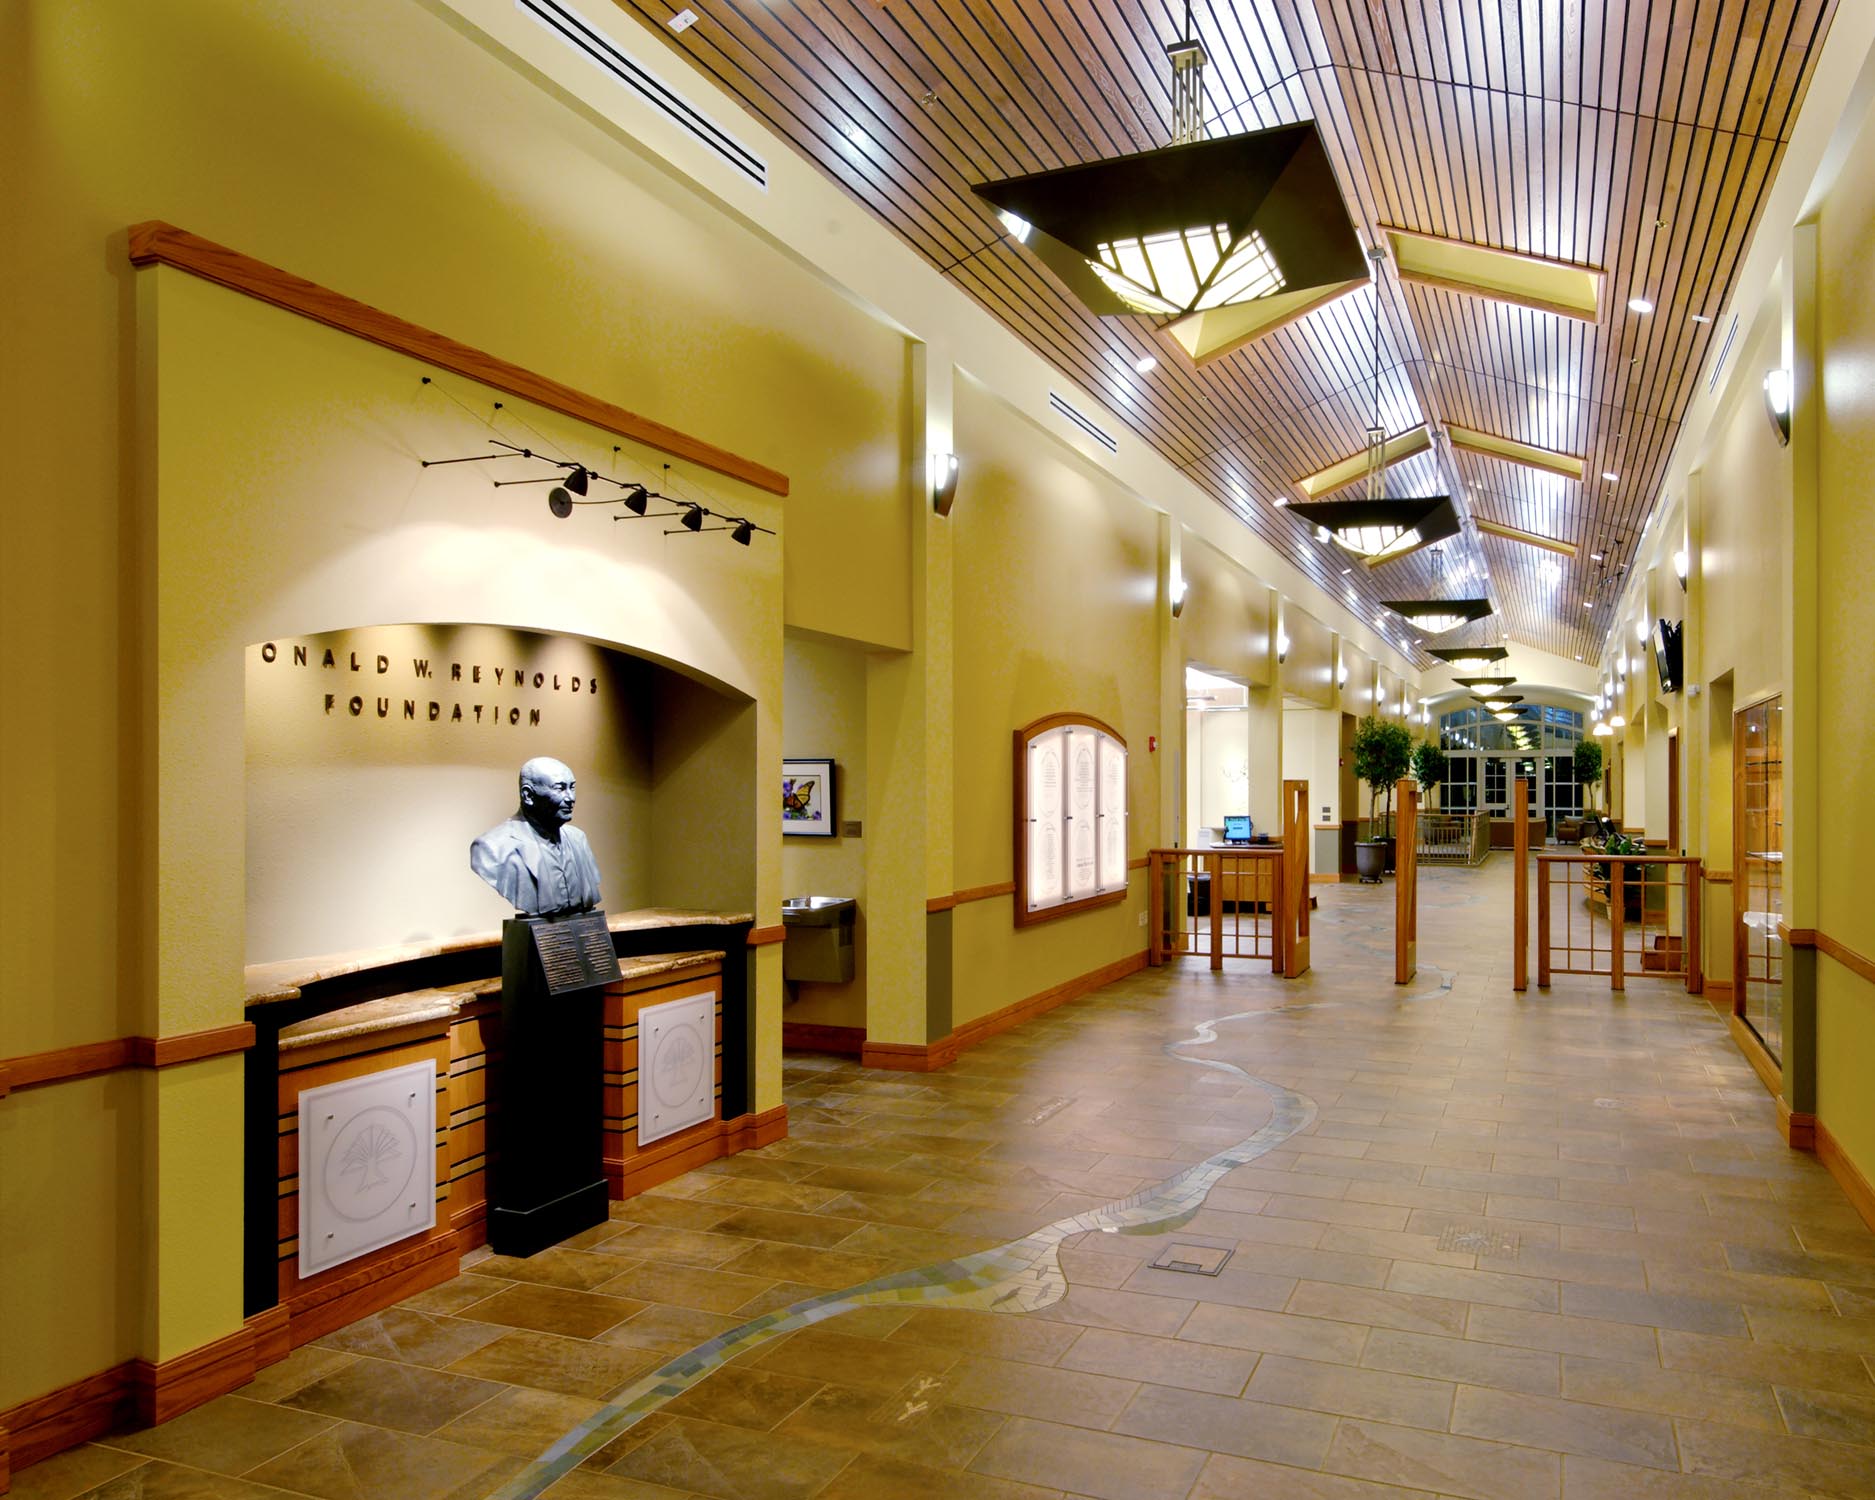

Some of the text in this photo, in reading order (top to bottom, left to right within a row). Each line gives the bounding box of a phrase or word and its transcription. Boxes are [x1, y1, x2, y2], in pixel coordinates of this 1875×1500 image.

[261, 642, 598, 694] ONALD W. REYNOLDS
[324, 693, 541, 727] FOUNDATION
